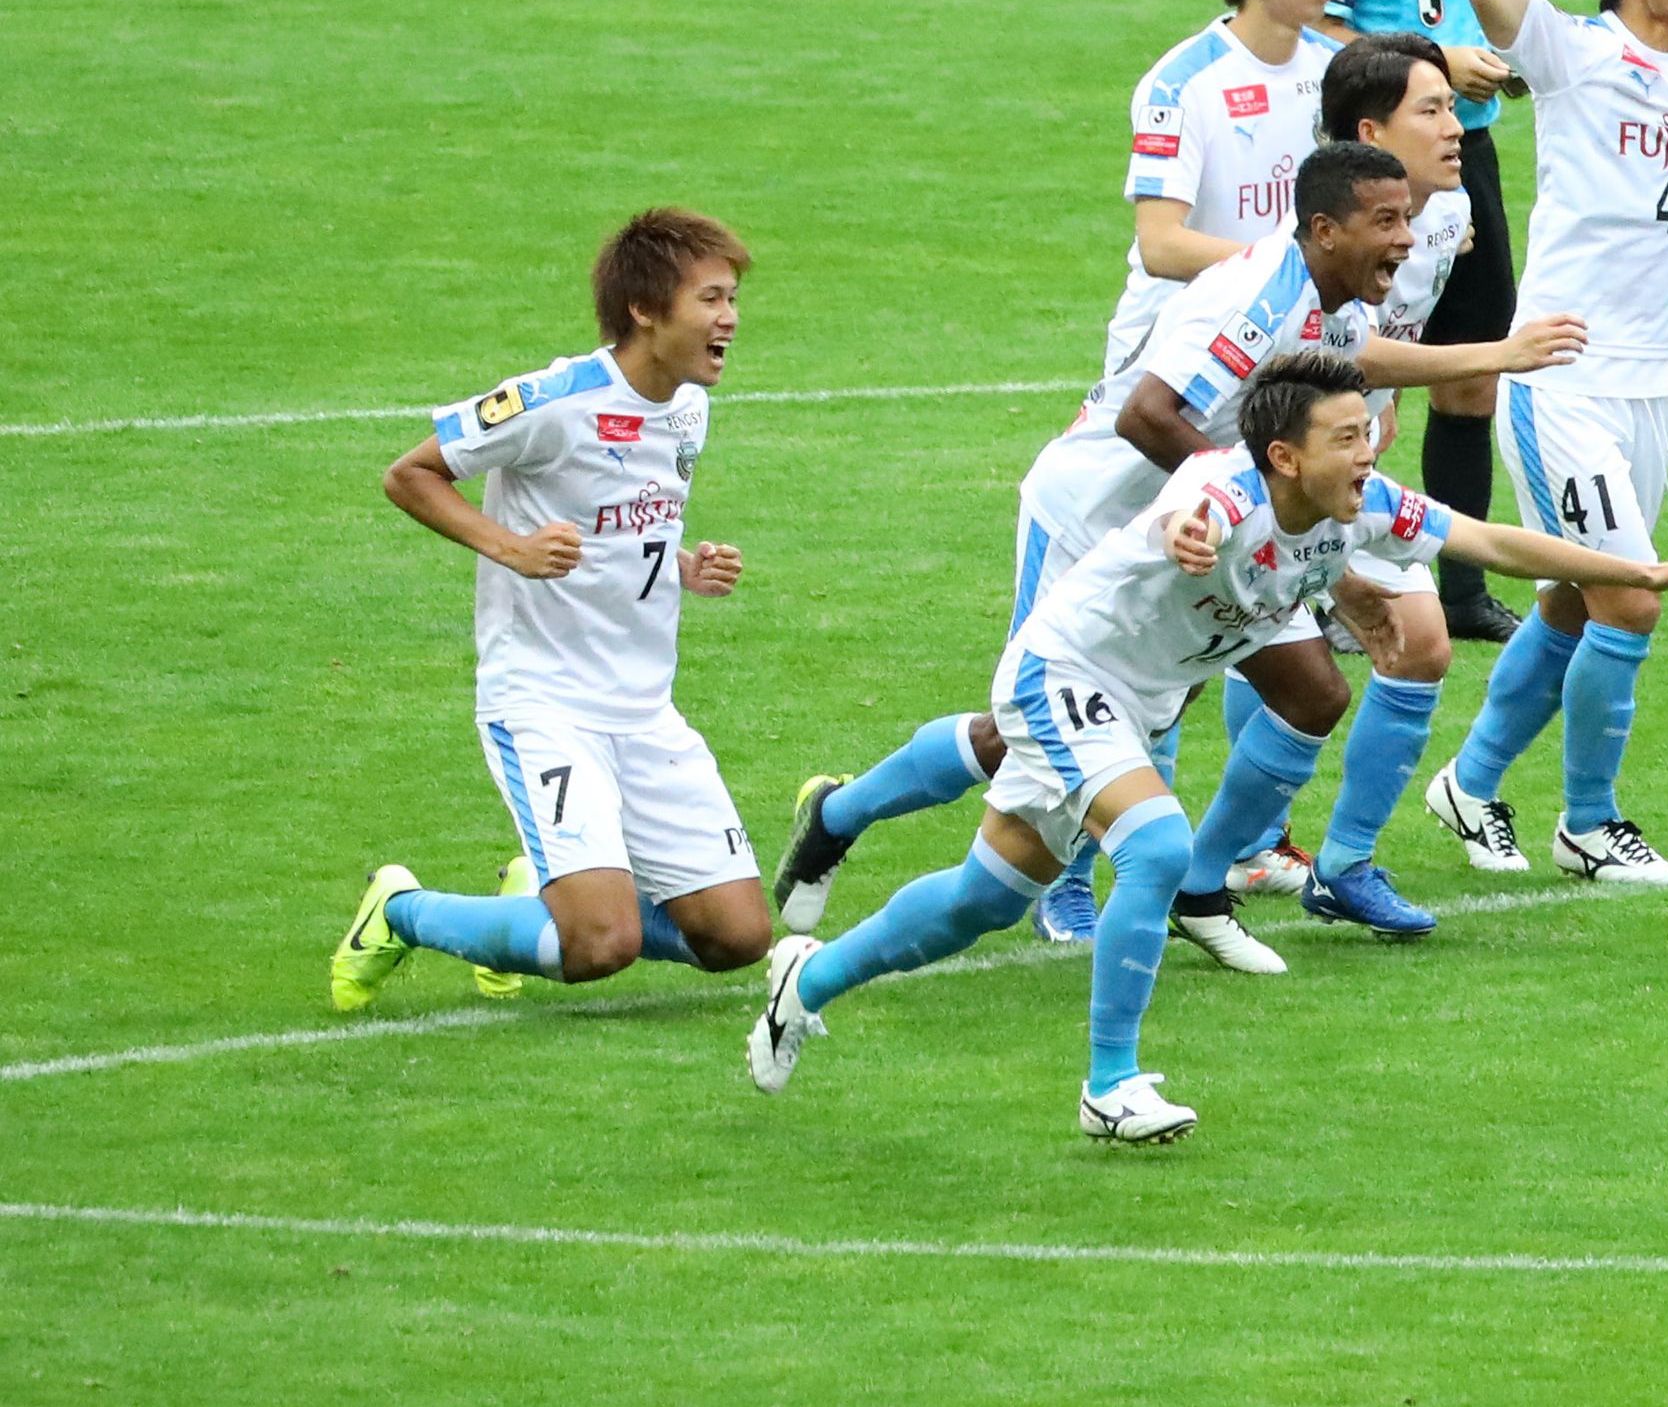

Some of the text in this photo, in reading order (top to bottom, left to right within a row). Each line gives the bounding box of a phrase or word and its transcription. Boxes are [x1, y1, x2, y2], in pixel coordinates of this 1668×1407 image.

[1296, 79, 1321, 96] REN
[1238, 179, 1295, 227] FUJI
[1562, 474, 1619, 534] 41
[637, 541, 667, 601] 7
[1057, 688, 1118, 731] 16
[541, 766, 572, 825] 7
